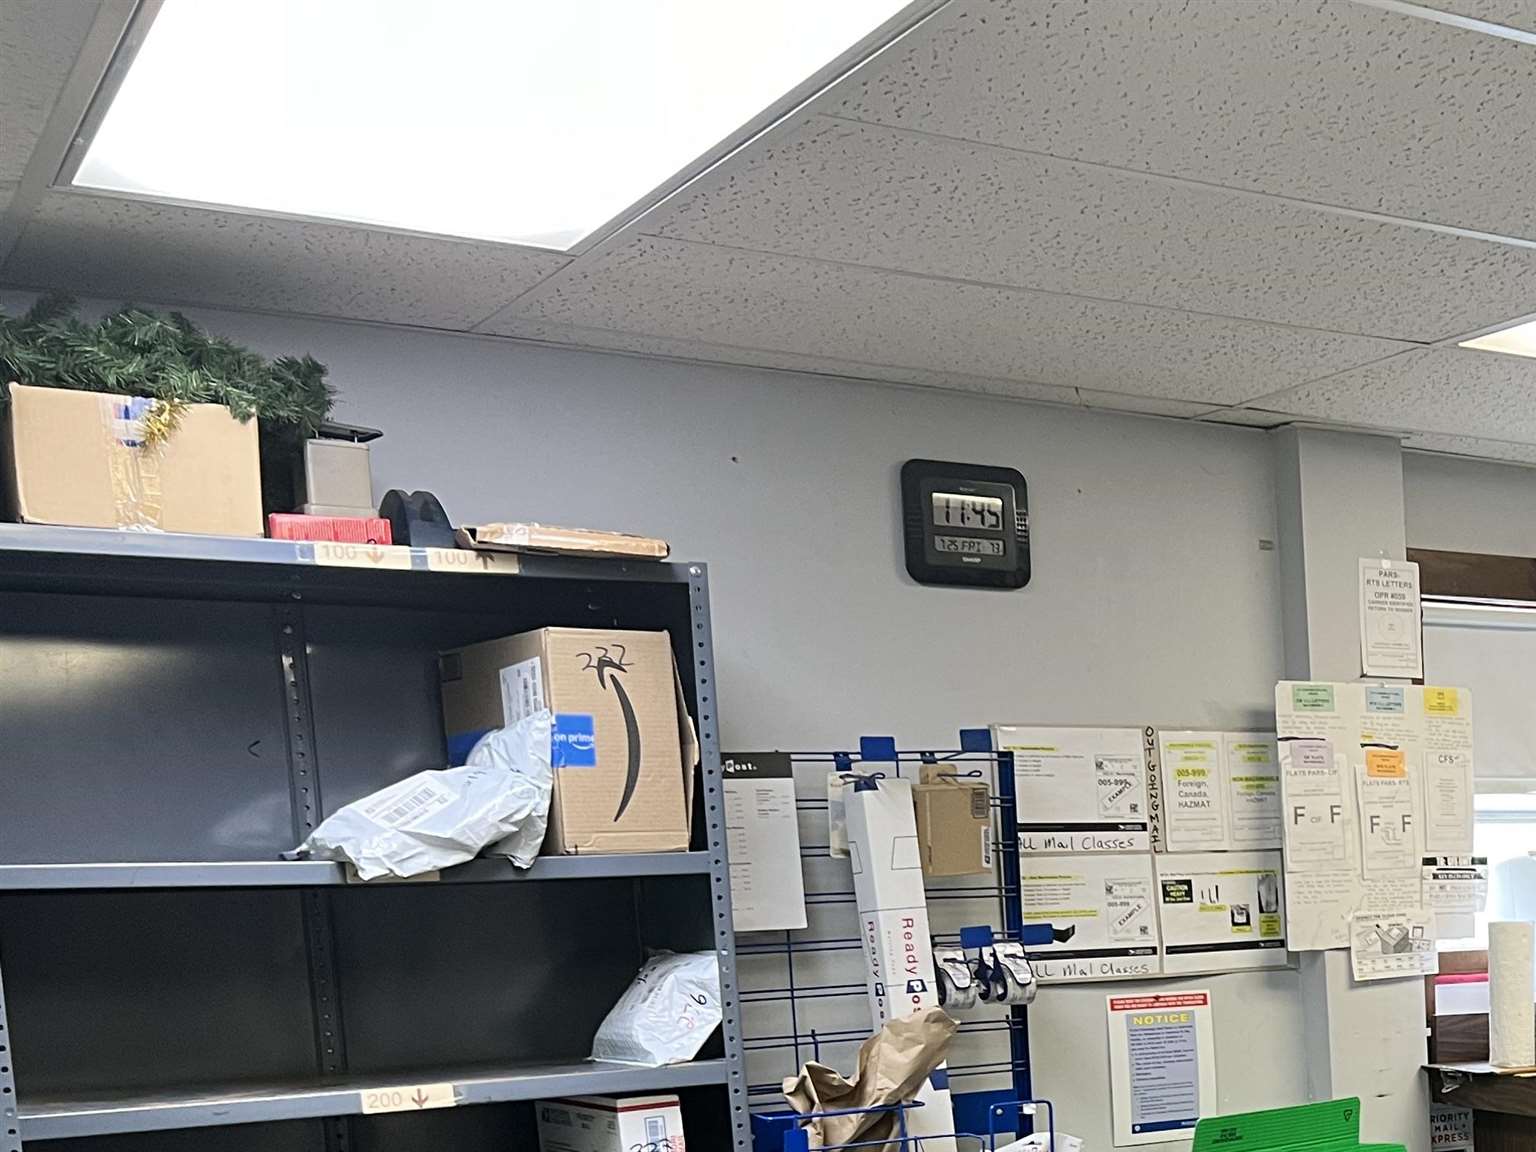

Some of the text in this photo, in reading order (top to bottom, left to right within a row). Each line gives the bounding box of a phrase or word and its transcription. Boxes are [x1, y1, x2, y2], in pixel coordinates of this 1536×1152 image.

[945, 498, 1000, 528] 11:45
[323, 544, 357, 561] 100
[961, 541, 980, 552] FRI
[436, 550, 468, 565] 100
[1382, 580, 1413, 589] LETTERS
[576, 644, 635, 670] 222
[554, 734, 567, 742] on
[1177, 780, 1209, 790] Foreign,
[1177, 790, 1209, 799] Canada,
[1177, 800, 1211, 809] HAZMAT
[1293, 806, 1306, 825] F
[1330, 805, 1342, 824] F
[1370, 814, 1412, 833] F F
[1045, 836, 1134, 850] Mail Classes
[901, 917, 928, 1013] ReadyPo
[1100, 963, 1150, 975] Classes
[866, 920, 886, 1029] ReadyPos
[1133, 1013, 1190, 1026] NOTICE
[367, 1091, 403, 1108] 200
[1430, 1112, 1470, 1124] RIORITY
[1431, 1133, 1470, 1144] XPRESS
